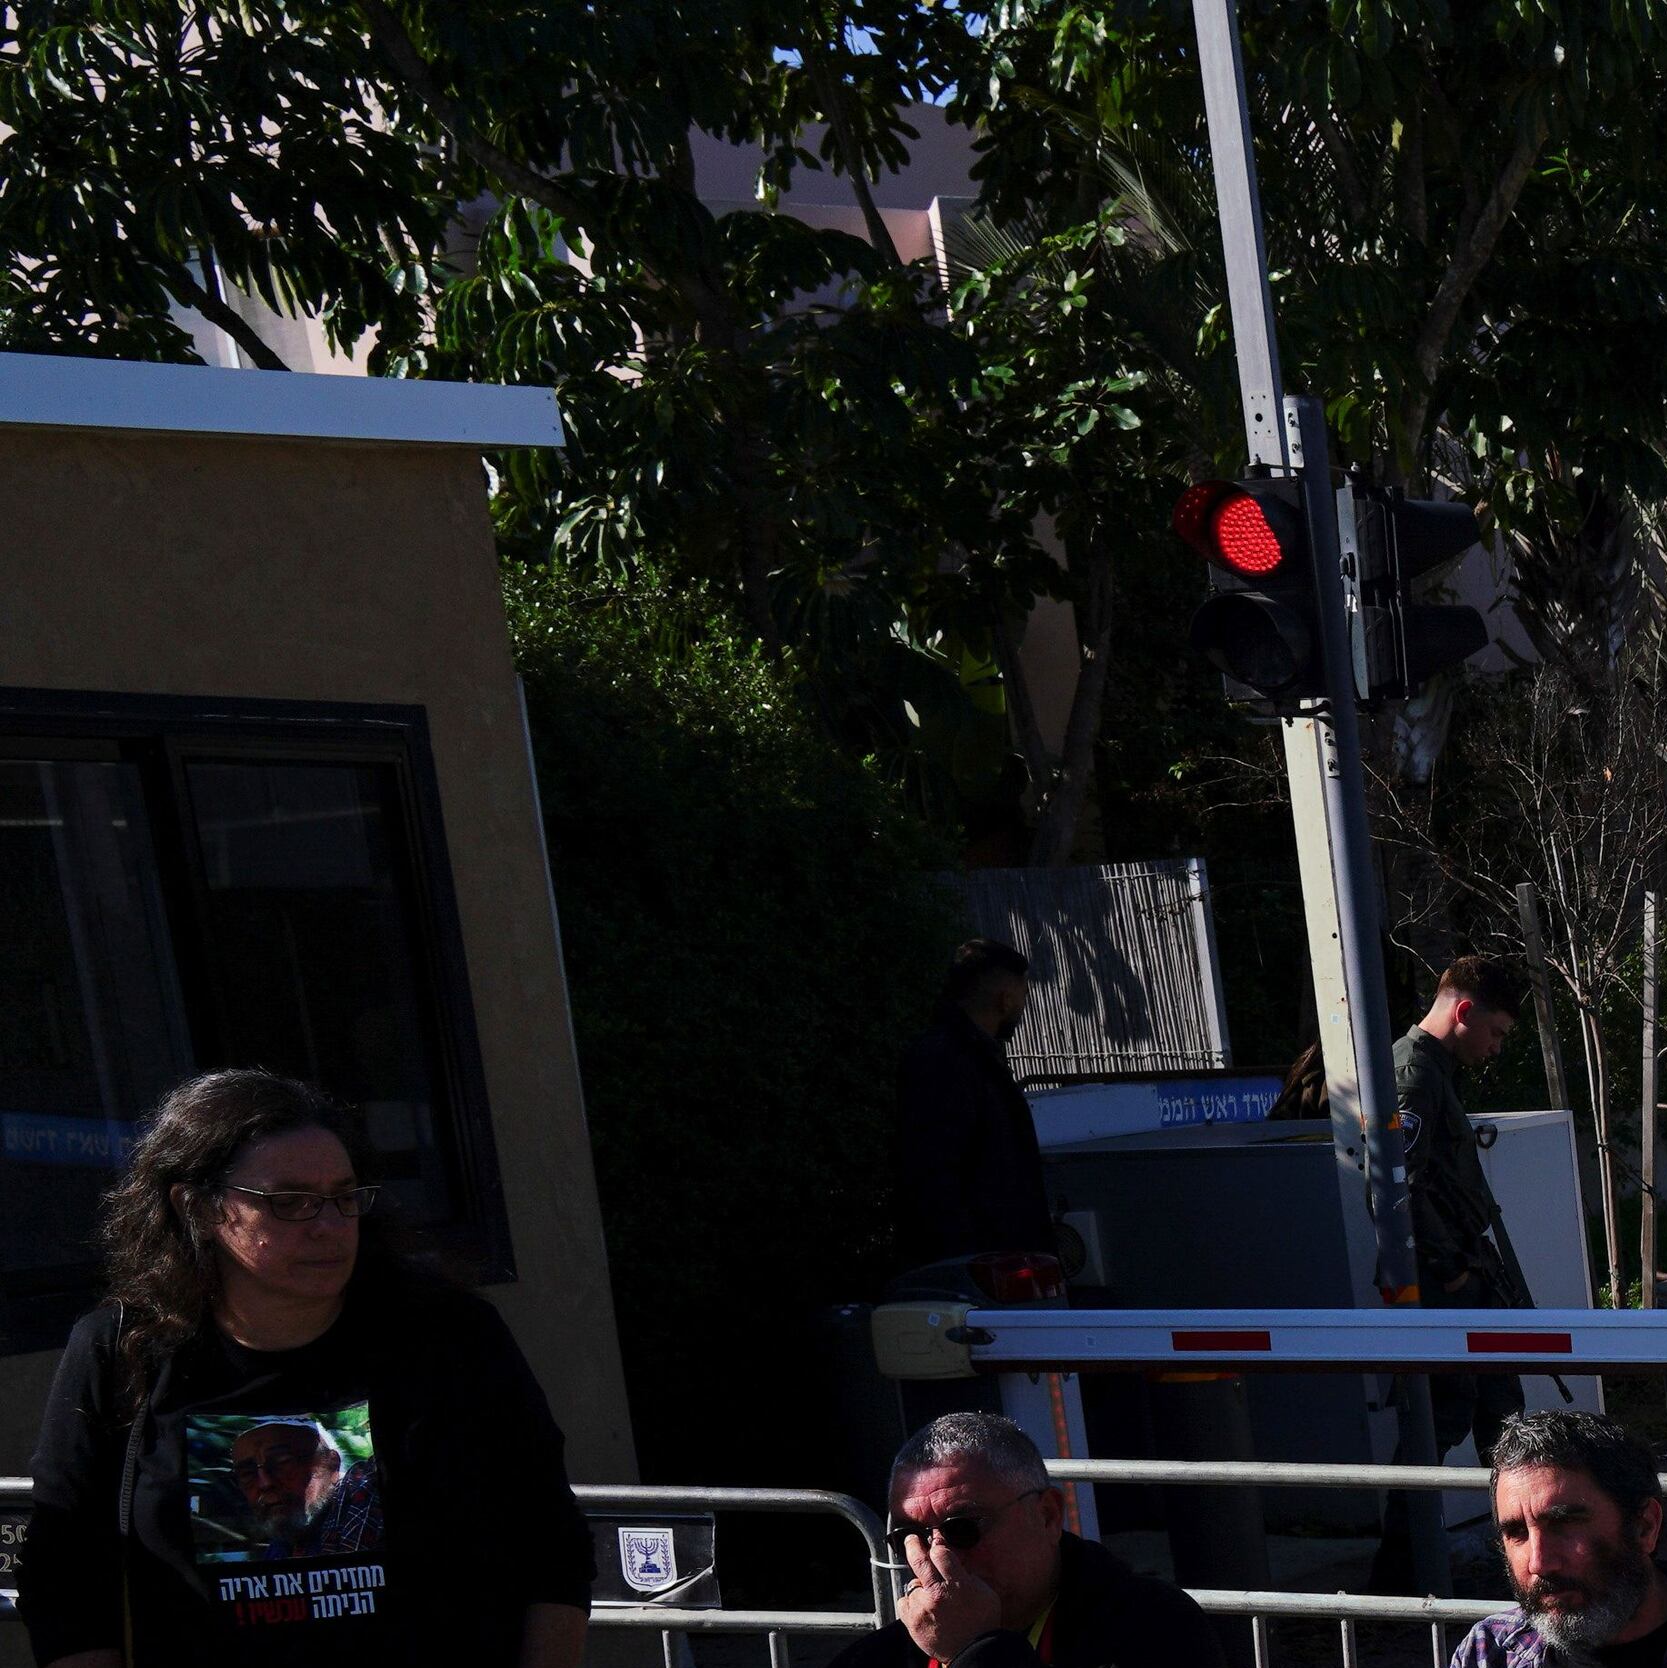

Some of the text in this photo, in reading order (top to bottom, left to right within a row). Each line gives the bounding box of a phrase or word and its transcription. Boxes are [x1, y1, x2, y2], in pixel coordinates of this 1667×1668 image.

[1160, 1091, 1281, 1121] שרד ראש הממ
[219, 1564, 386, 1601] מחזירים את אריה
[311, 1590, 376, 1619] הביתה
